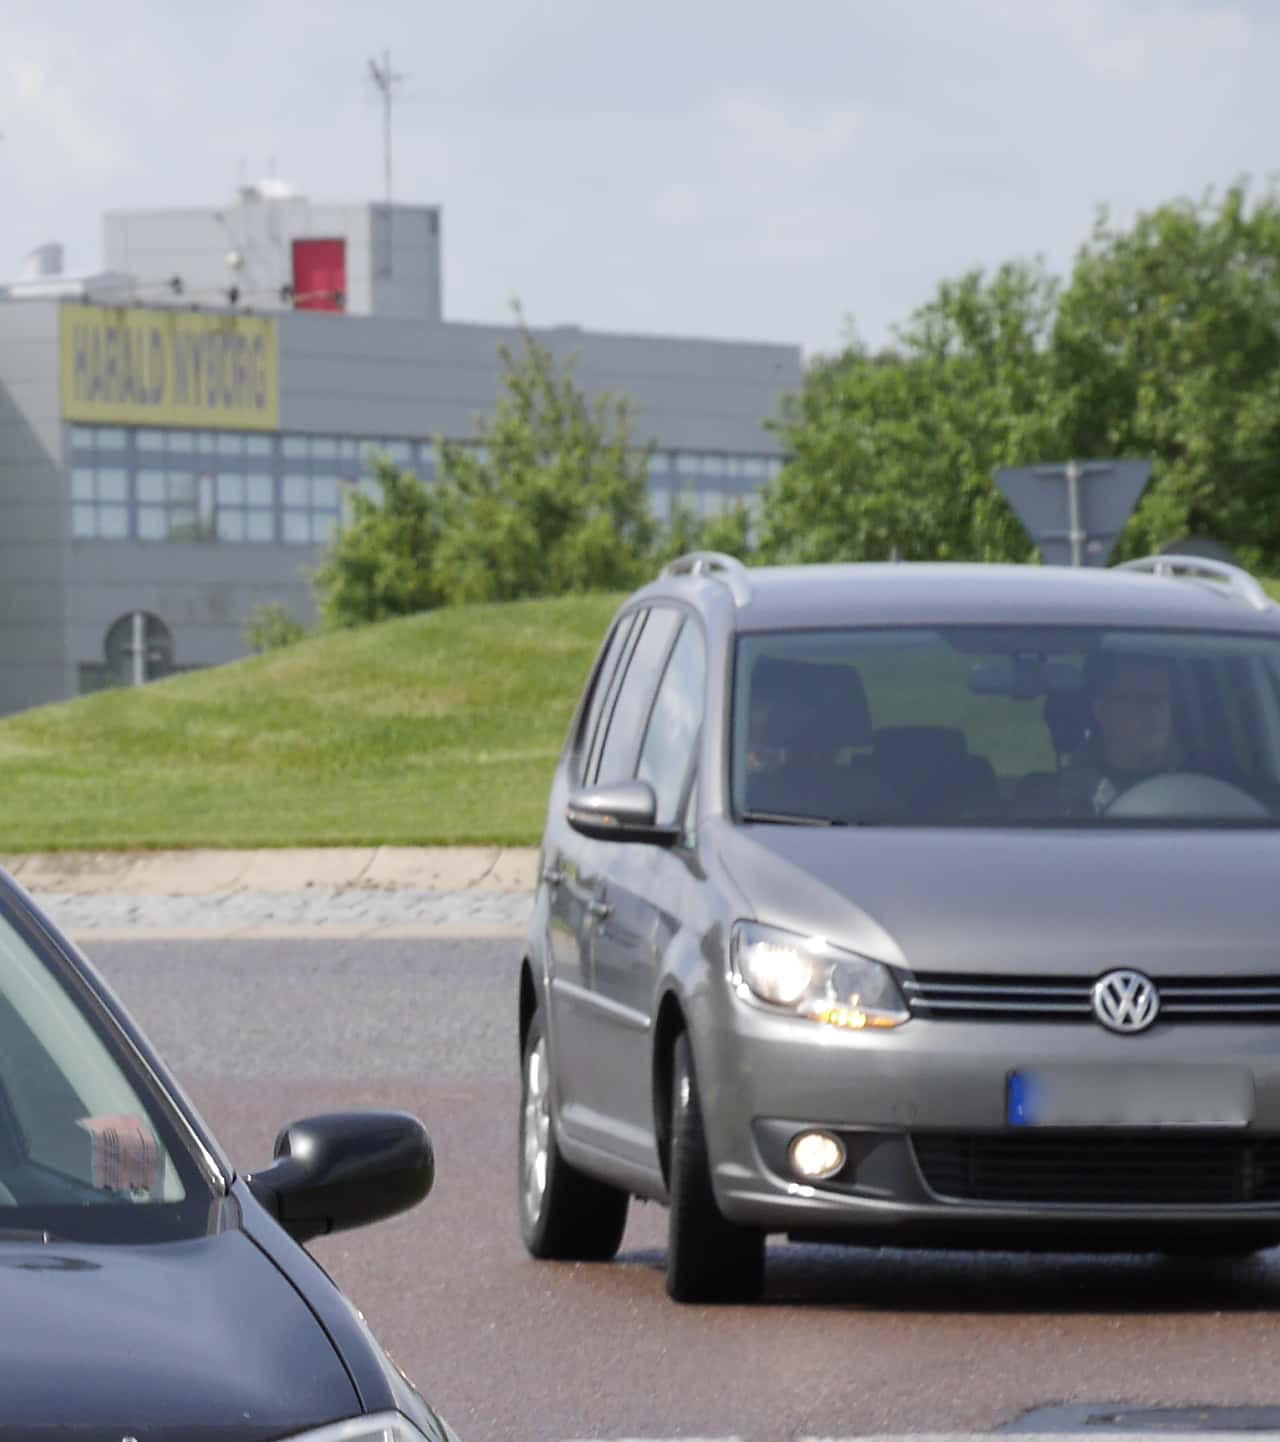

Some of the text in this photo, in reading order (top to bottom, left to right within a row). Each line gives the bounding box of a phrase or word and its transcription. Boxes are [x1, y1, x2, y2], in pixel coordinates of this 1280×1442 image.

[72, 326, 267, 411] HARALD NYBORG
[1095, 970, 1159, 1032] VW
